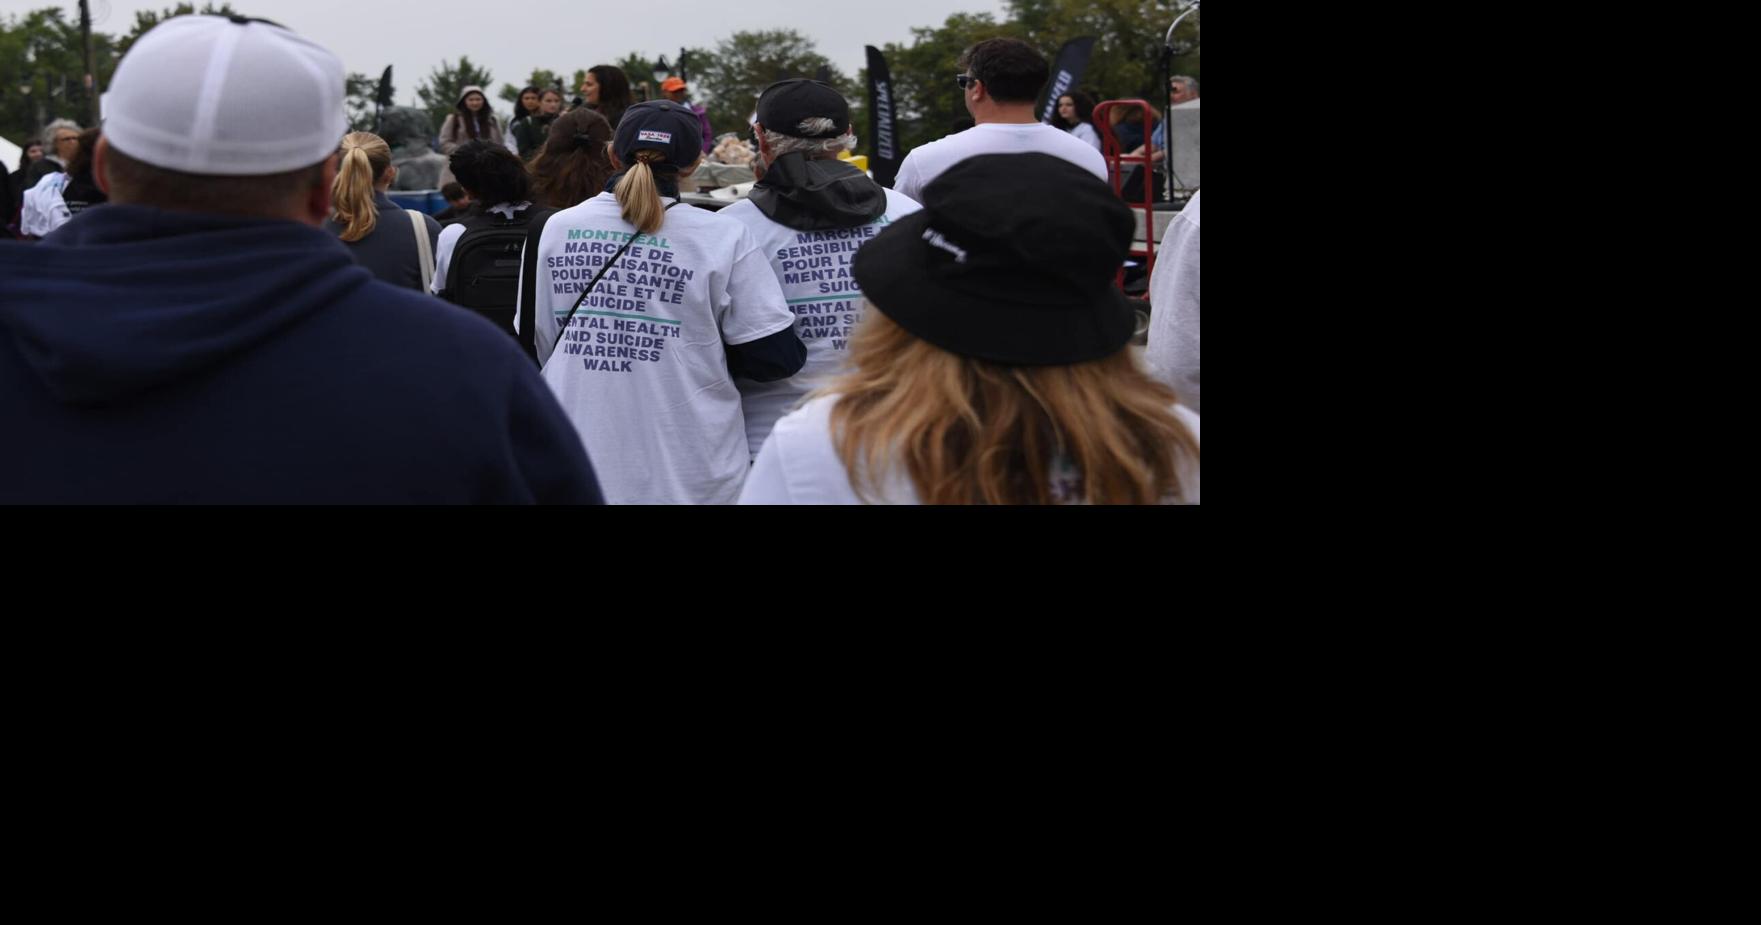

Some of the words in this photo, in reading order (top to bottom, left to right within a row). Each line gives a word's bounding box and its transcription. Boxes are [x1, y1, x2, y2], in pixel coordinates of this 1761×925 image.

[567, 229, 670, 248] MONTREAL
[796, 227, 875, 245] MARCHE
[564, 242, 643, 258] MARCHE
[648, 249, 674, 263] DE
[782, 256, 833, 272] POUR
[551, 269, 593, 281] POUR
[626, 272, 686, 293] SANTÉ
[819, 279, 862, 294] SUIC
[580, 296, 646, 312] SUICIDE
[633, 287, 655, 300] ET
[659, 291, 684, 304] LE
[613, 319, 680, 338] HEALTH
[799, 315, 837, 327] AND
[564, 330, 591, 342] AND
[596, 331, 665, 349] SUICIDE
[583, 358, 632, 372] WALK
